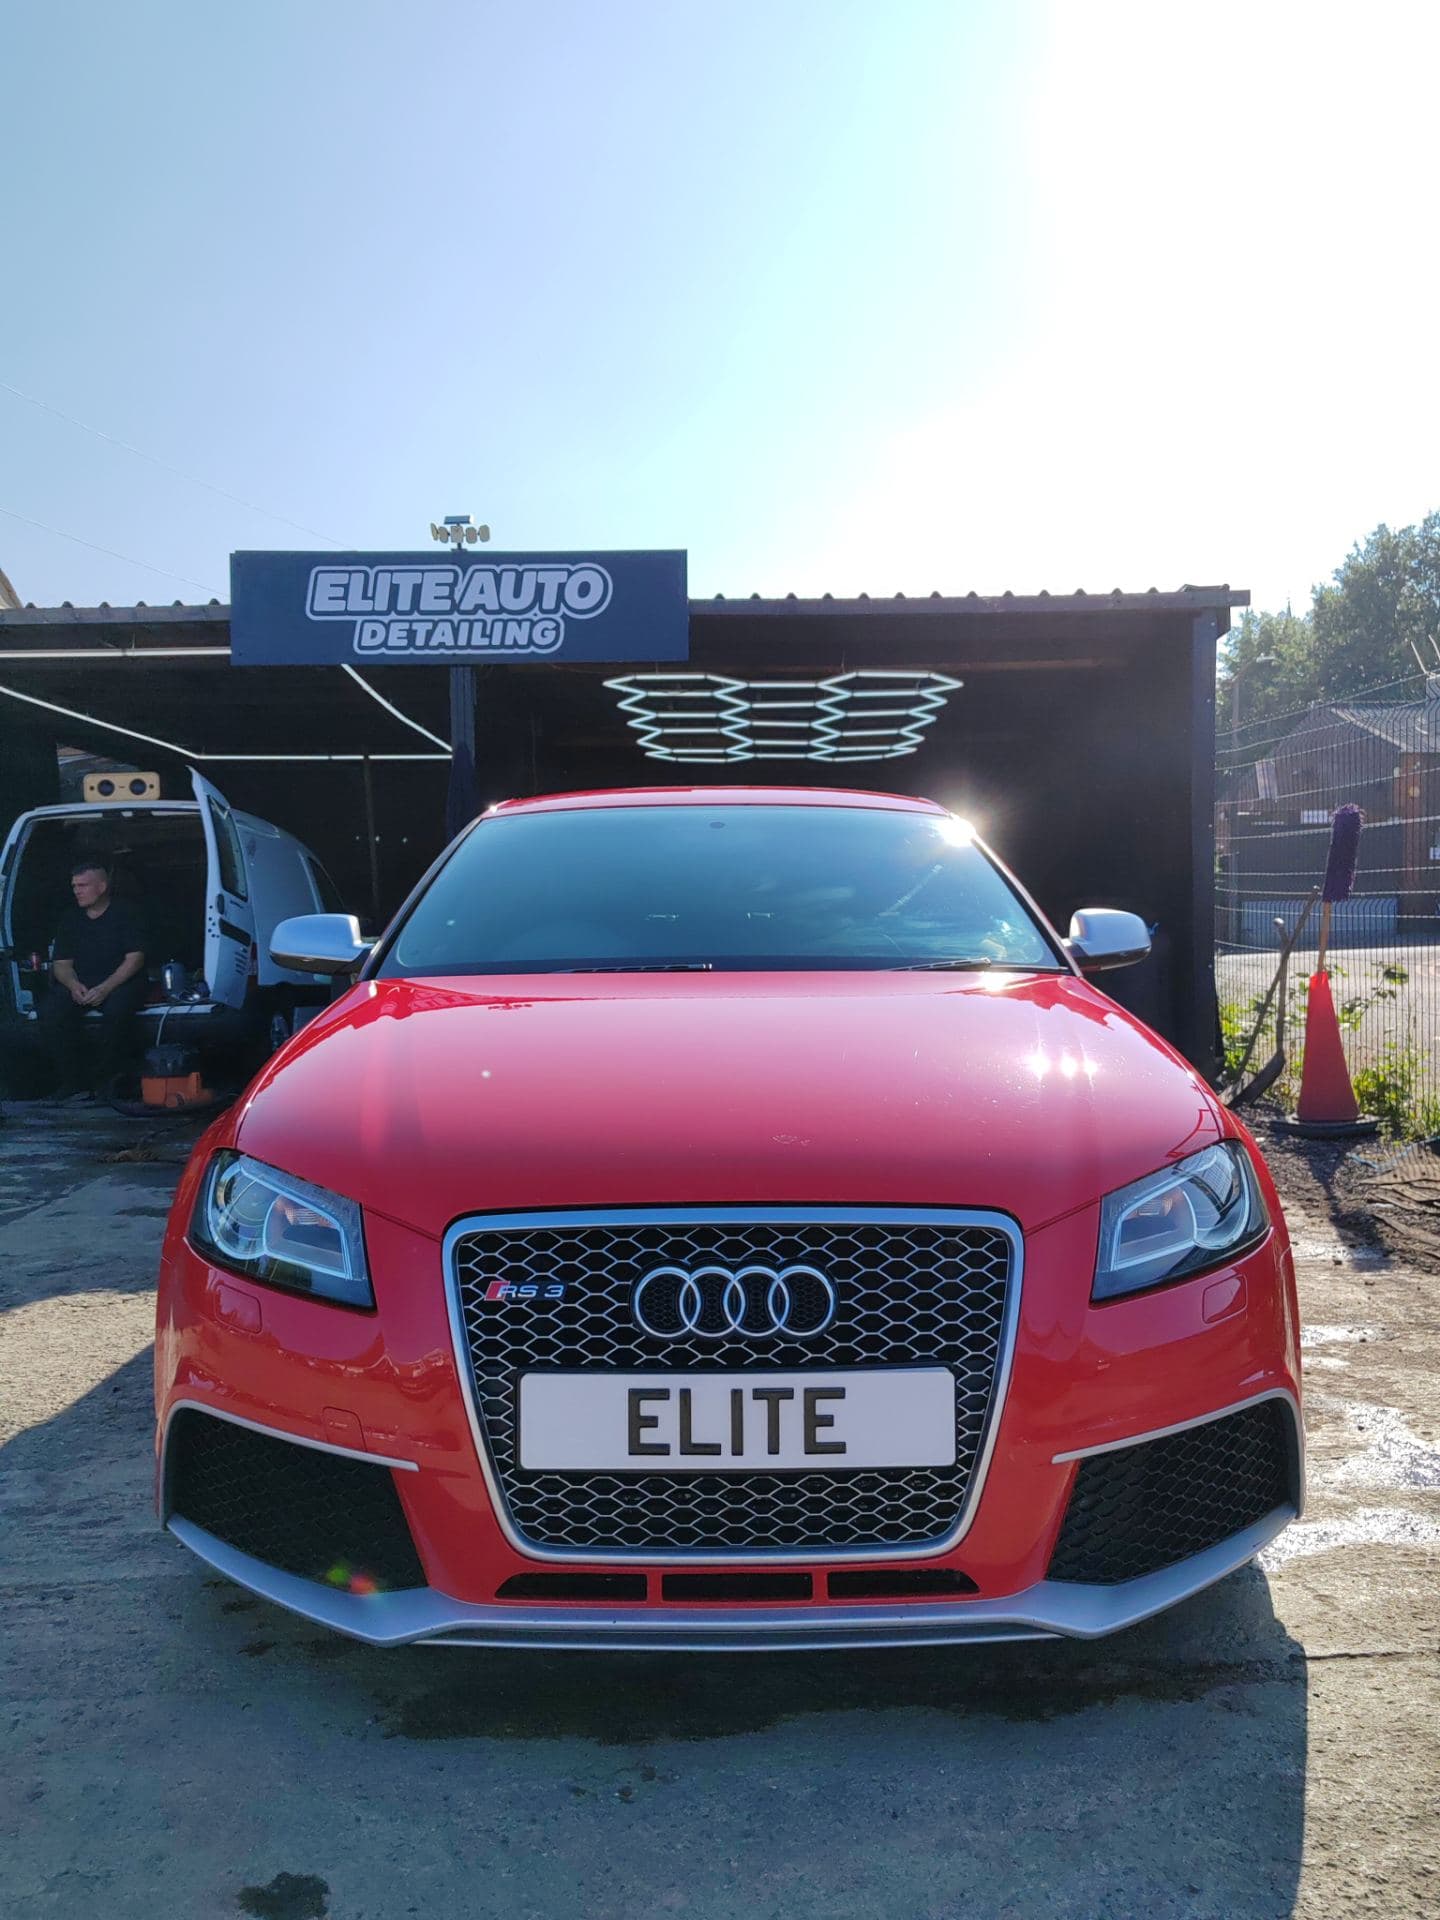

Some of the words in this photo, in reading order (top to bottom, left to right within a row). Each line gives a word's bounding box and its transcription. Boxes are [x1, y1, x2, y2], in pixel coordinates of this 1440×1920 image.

[312, 570, 455, 612] ELITE
[457, 568, 605, 611] AUTO
[360, 620, 557, 647] DETAILING
[627, 1386, 847, 1456] ELITE
